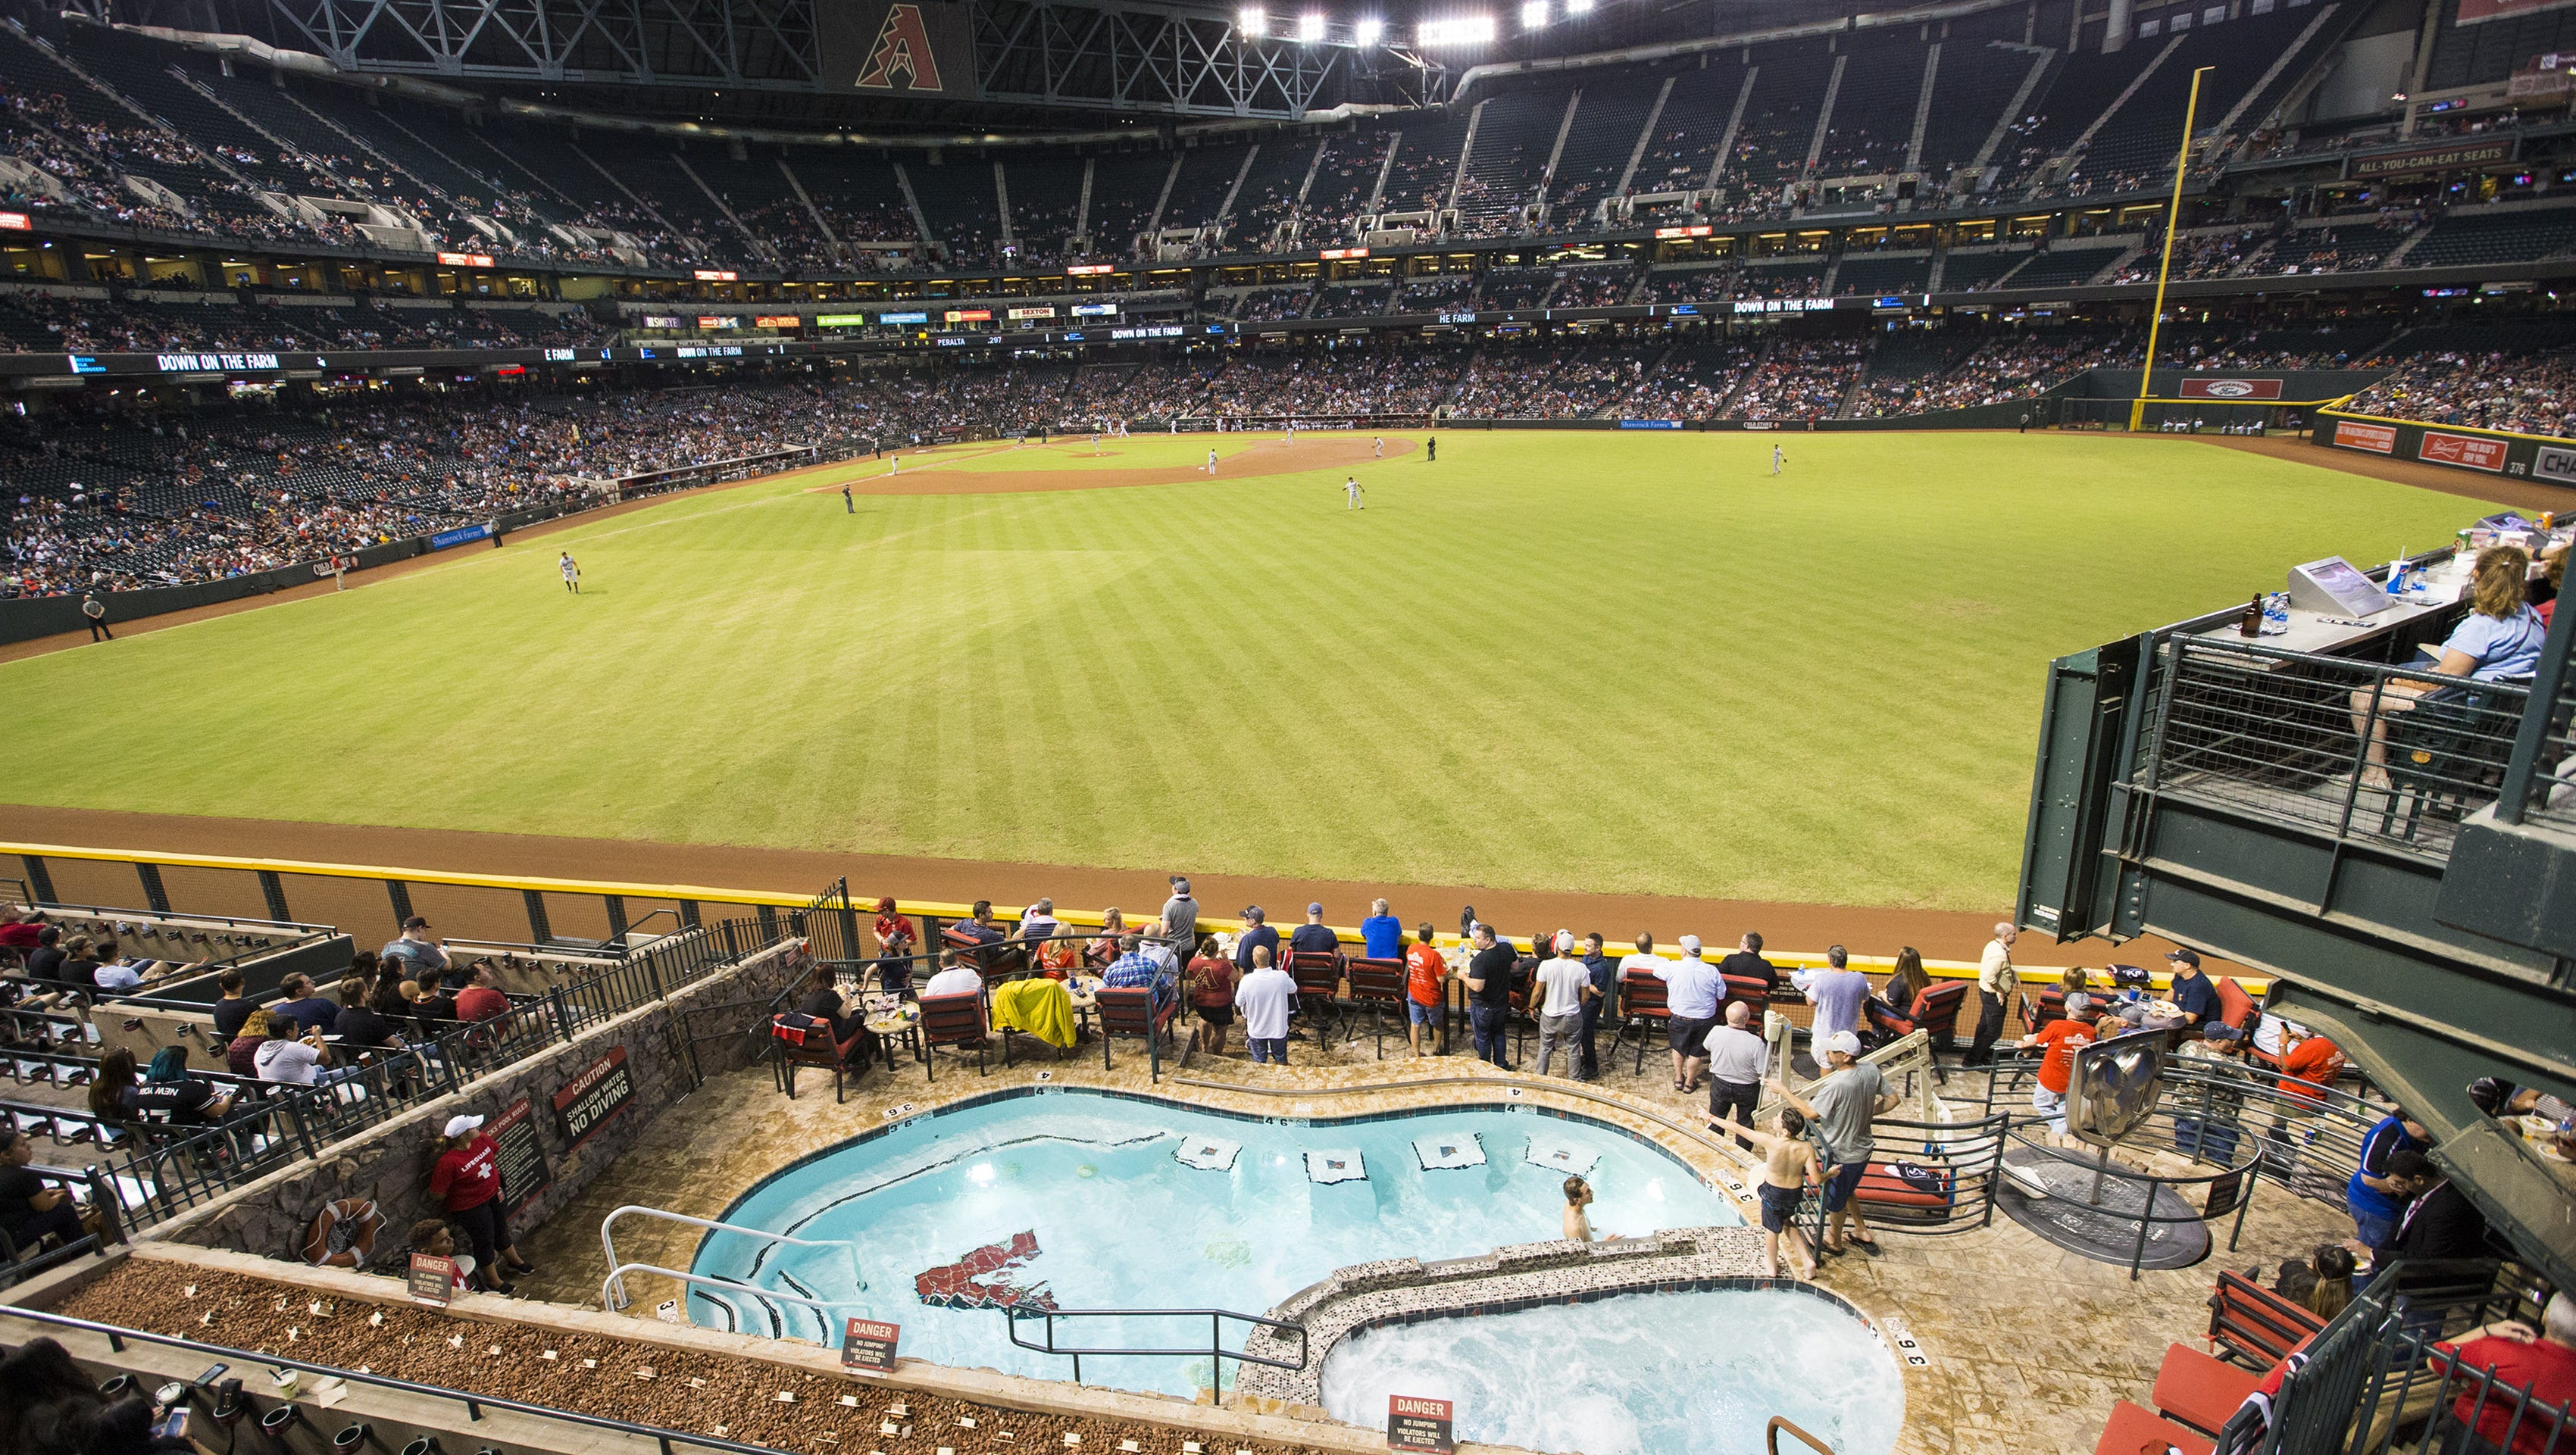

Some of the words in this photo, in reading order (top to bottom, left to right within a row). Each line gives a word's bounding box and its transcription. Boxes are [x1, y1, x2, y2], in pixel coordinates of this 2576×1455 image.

[2359, 152, 2460, 173] ALL-YOU-CAN-EAT
[2463, 148, 2502, 161] SEATS
[1734, 301, 1764, 313] DOWN
[1767, 301, 1781, 312] ON
[1784, 300, 1802, 311] THE
[1805, 298, 1834, 310] FARM
[1453, 314, 1475, 323] FARM
[1112, 329, 1134, 339] DOWN
[1136, 328, 1146, 338] ON
[1148, 327, 1161, 337] THE
[1163, 326, 1183, 336] FARM
[938, 338, 965, 346] PERALTA
[552, 348, 574, 361] FARM
[677, 347, 696, 358] DOWN
[697, 347, 706, 357] ON
[708, 347, 721, 356] THE
[724, 346, 742, 356] FARM
[158, 354, 199, 371] DOWN
[200, 354, 220, 370] ON
[220, 354, 246, 370] THE
[245, 354, 280, 370] FARM
[1621, 420, 1649, 429] Shamrock
[1651, 420, 1668, 429] Farms
[2509, 462, 2525, 475] 376
[433, 532, 463, 547] Shamrock
[463, 528, 482, 541] Farms
[313, 562, 330, 576] COLD
[572, 1058, 611, 1095] CAUTION
[154, 1087, 180, 1097] NEW
[567, 1088, 600, 1121] SHALLOW
[601, 1069, 625, 1093] WATER
[1036, 1087, 1044, 1096] 4
[570, 1113, 588, 1137] NO
[589, 1080, 629, 1120] DIVING
[498, 1116, 512, 1129] POOL
[511, 1101, 528, 1118] RULES
[417, 1257, 449, 1272] DANGER
[414, 1279, 434, 1288] VIOLATORS
[660, 1301, 674, 1310] 3
[853, 1322, 893, 1338] DANGER
[864, 1341, 884, 1350] JUMPING
[1898, 1340, 1916, 1348] 6
[850, 1347, 874, 1356] VIOLATORS
[874, 1350, 886, 1359] WILL
[861, 1355, 881, 1364] EJECTED
[1909, 1357, 1926, 1365] 3
[1397, 1398, 1444, 1416] DANGER
[1412, 1420, 1437, 1429] JUMPING
[1396, 1427, 1427, 1438] VIOLATORS
[1427, 1431, 1441, 1439] WILL
[1412, 1436, 1436, 1446] EJECTED
